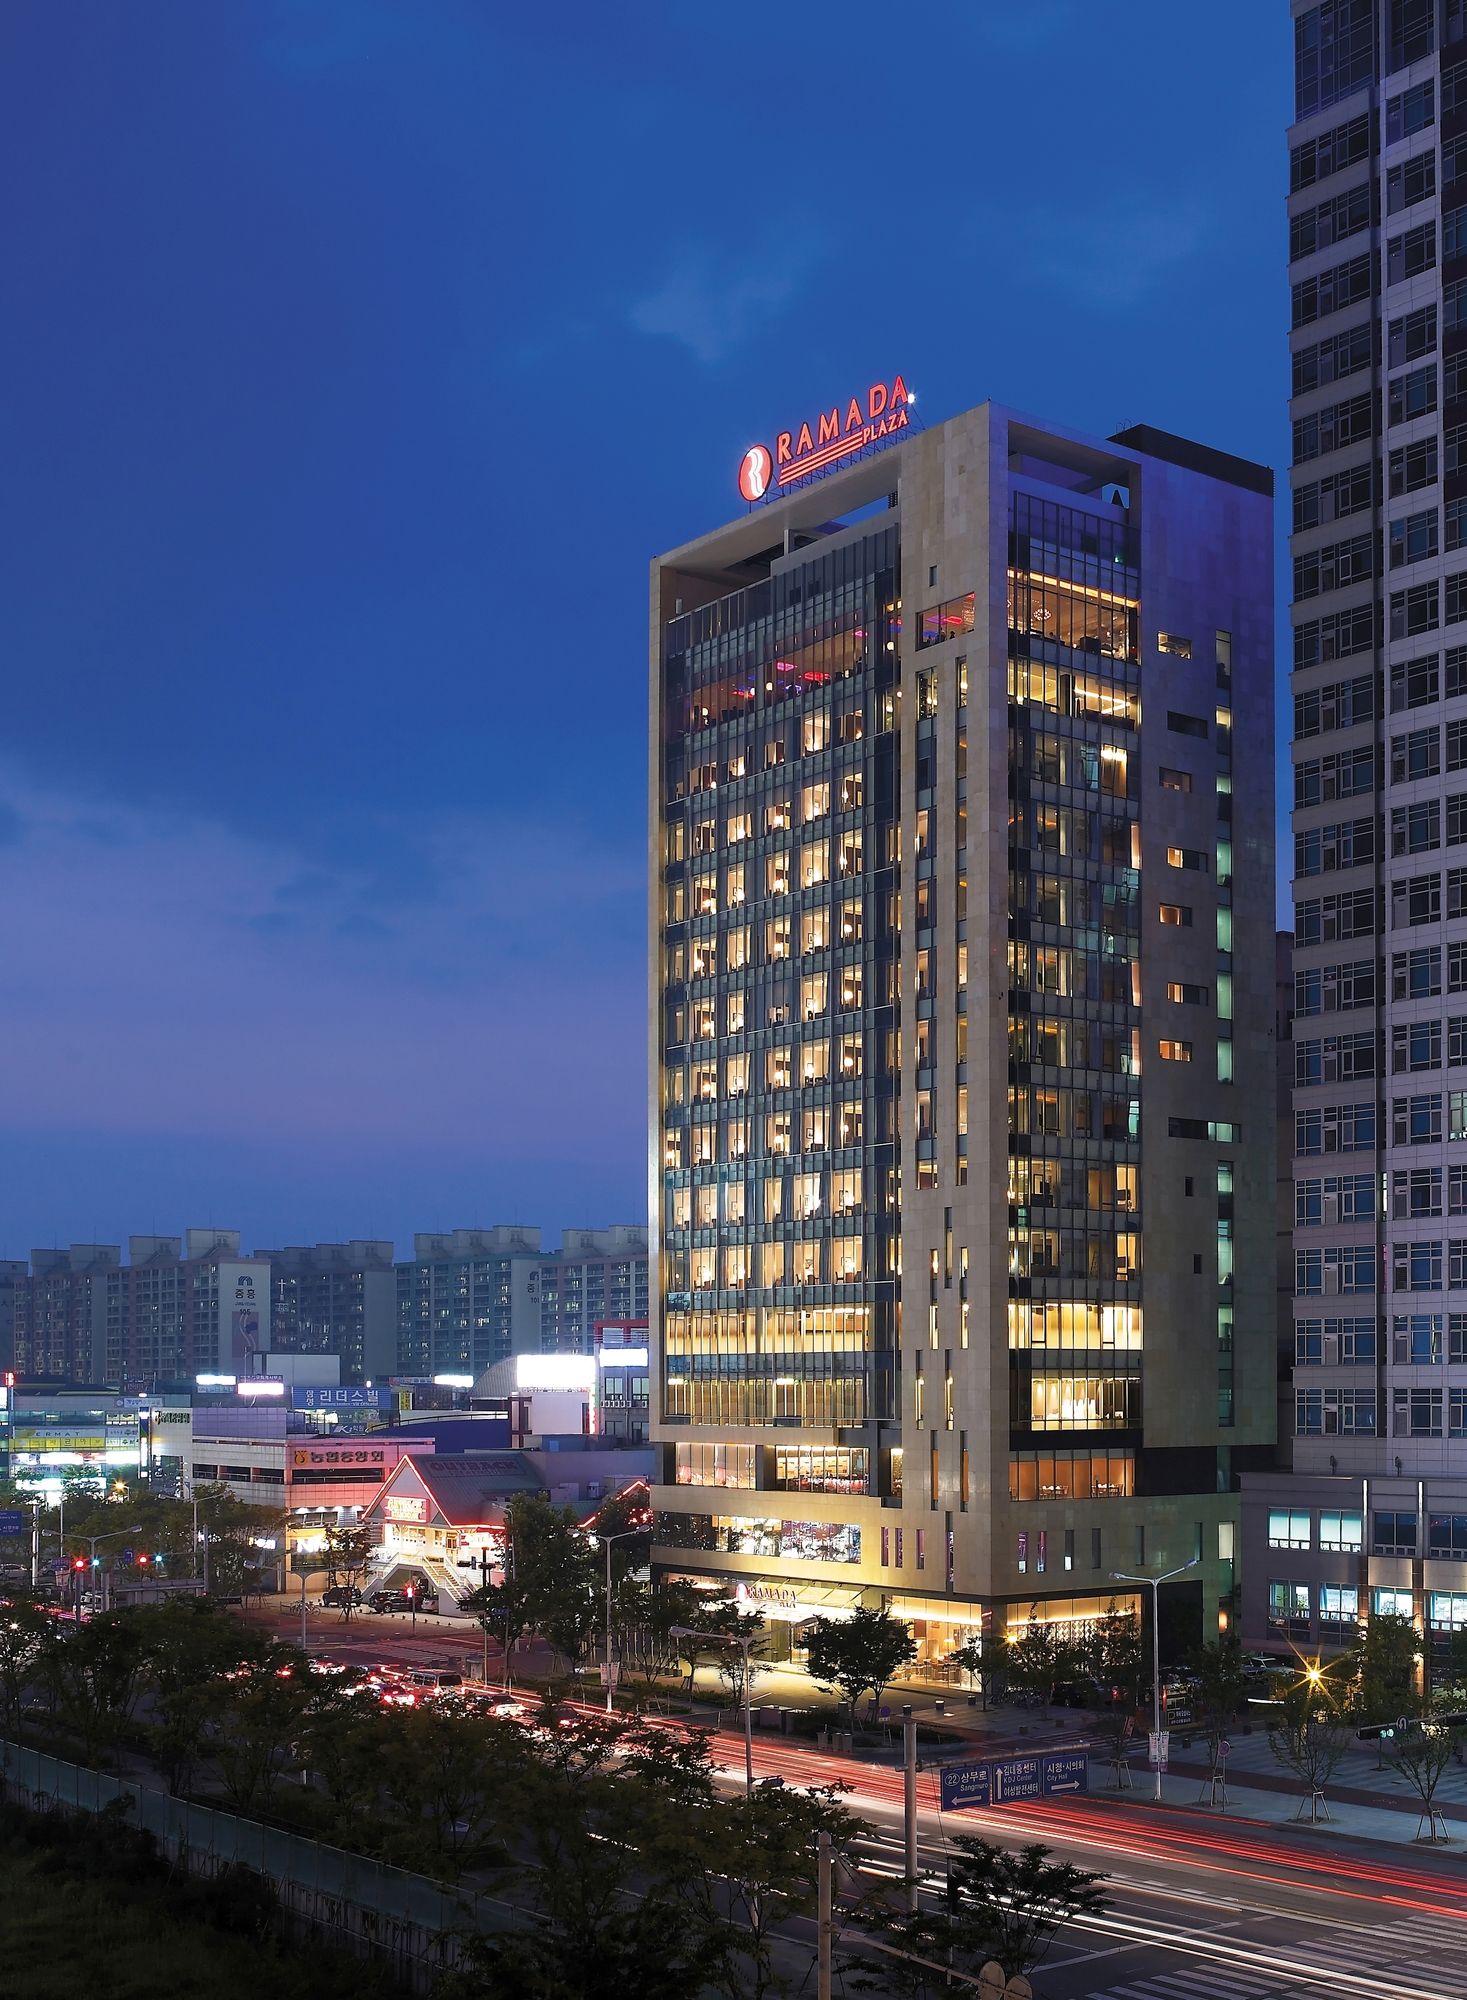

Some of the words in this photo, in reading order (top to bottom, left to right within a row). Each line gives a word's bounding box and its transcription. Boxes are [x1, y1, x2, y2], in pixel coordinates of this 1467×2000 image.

[776, 374, 909, 465] RAMADA
[861, 409, 909, 444] PLAZA
[320, 1389, 378, 1403] 리더스빌
[311, 1450, 384, 1463] 농협중앙회
[1047, 1759, 1085, 1774] 시청·시의회
[946, 1774, 958, 1785] 22
[960, 1770, 988, 1784] 상무로
[1046, 1774, 1058, 1782] City
[960, 1782, 989, 1792] Sangmuro
